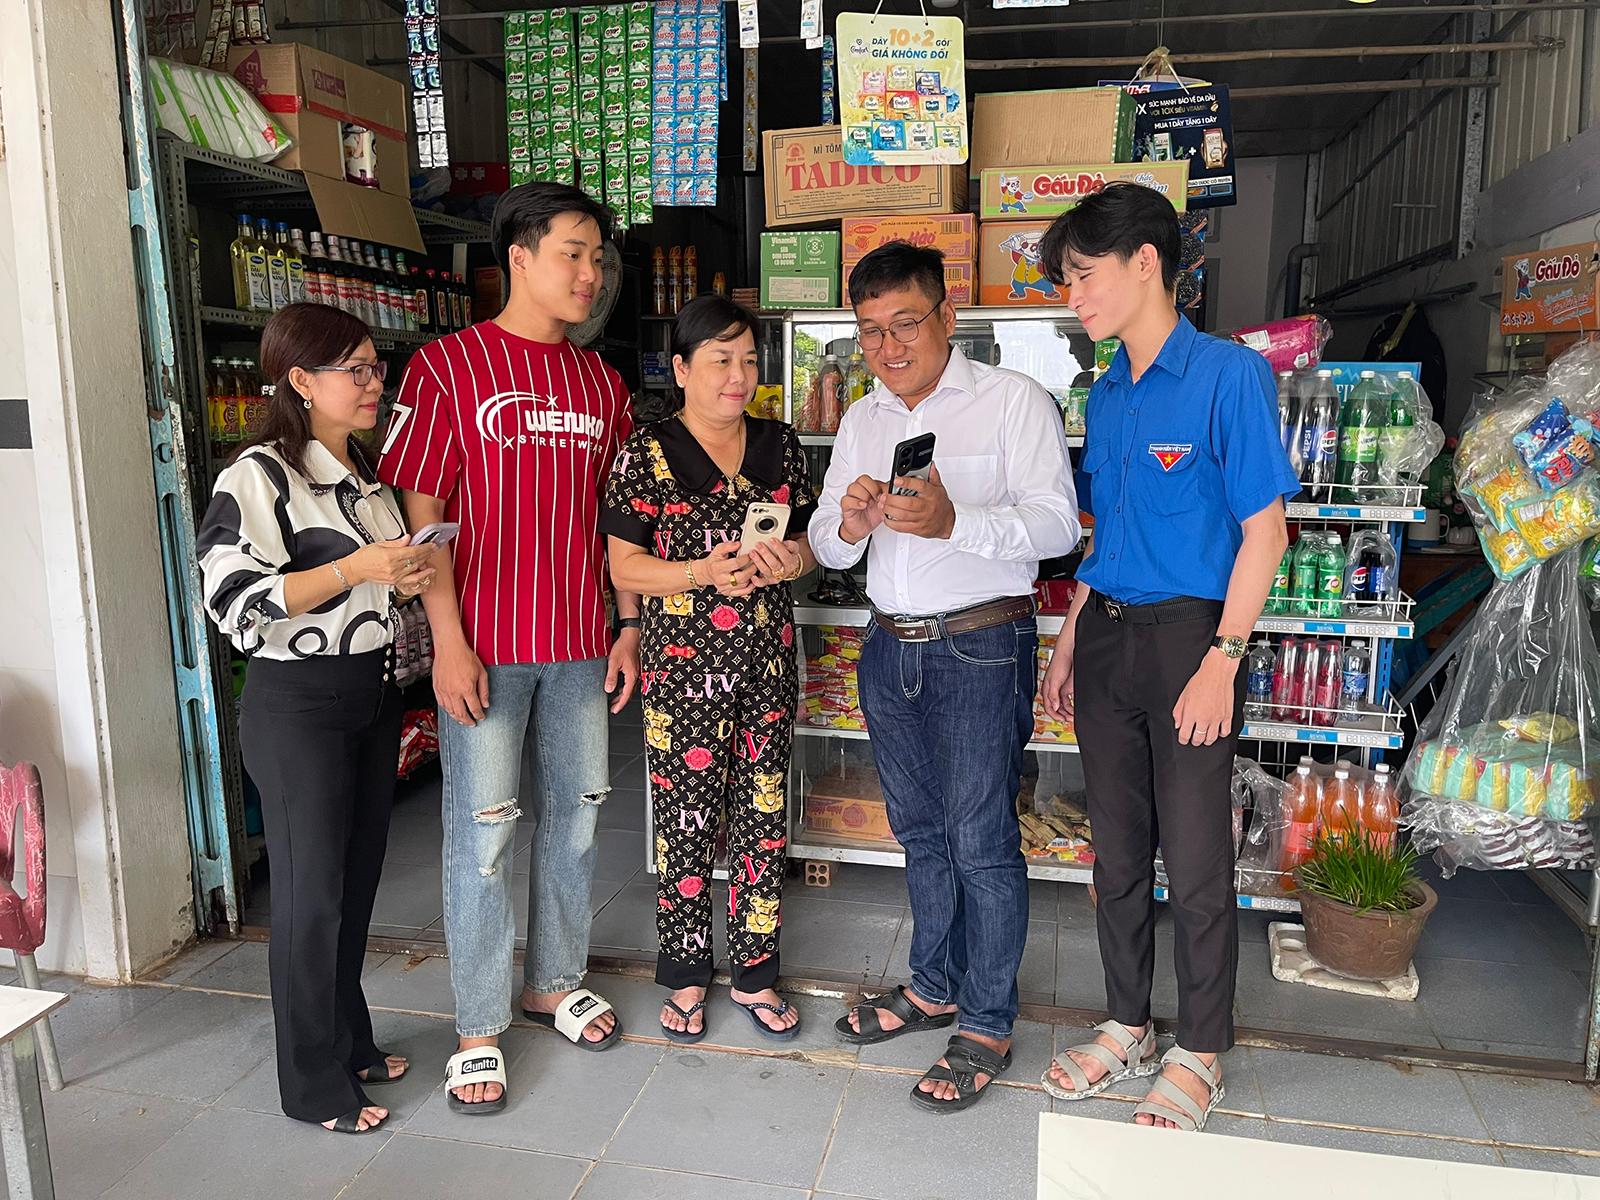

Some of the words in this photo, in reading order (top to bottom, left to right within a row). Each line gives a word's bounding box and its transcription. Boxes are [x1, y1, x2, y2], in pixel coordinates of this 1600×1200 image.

[872, 47, 889, 58] GIÁ
[892, 48, 927, 59] KHÔNG
[814, 145, 823, 154] MÌ
[785, 160, 921, 191] TADICO
[1033, 175, 1076, 196] Gấu
[1536, 257, 1561, 281] Gấu
[1562, 254, 1580, 277] Đỏ
[381, 402, 412, 455] 7
[525, 410, 605, 439] WENKO
[519, 435, 603, 453] STREETWEAR
[1303, 430, 1311, 459] PEPSI
